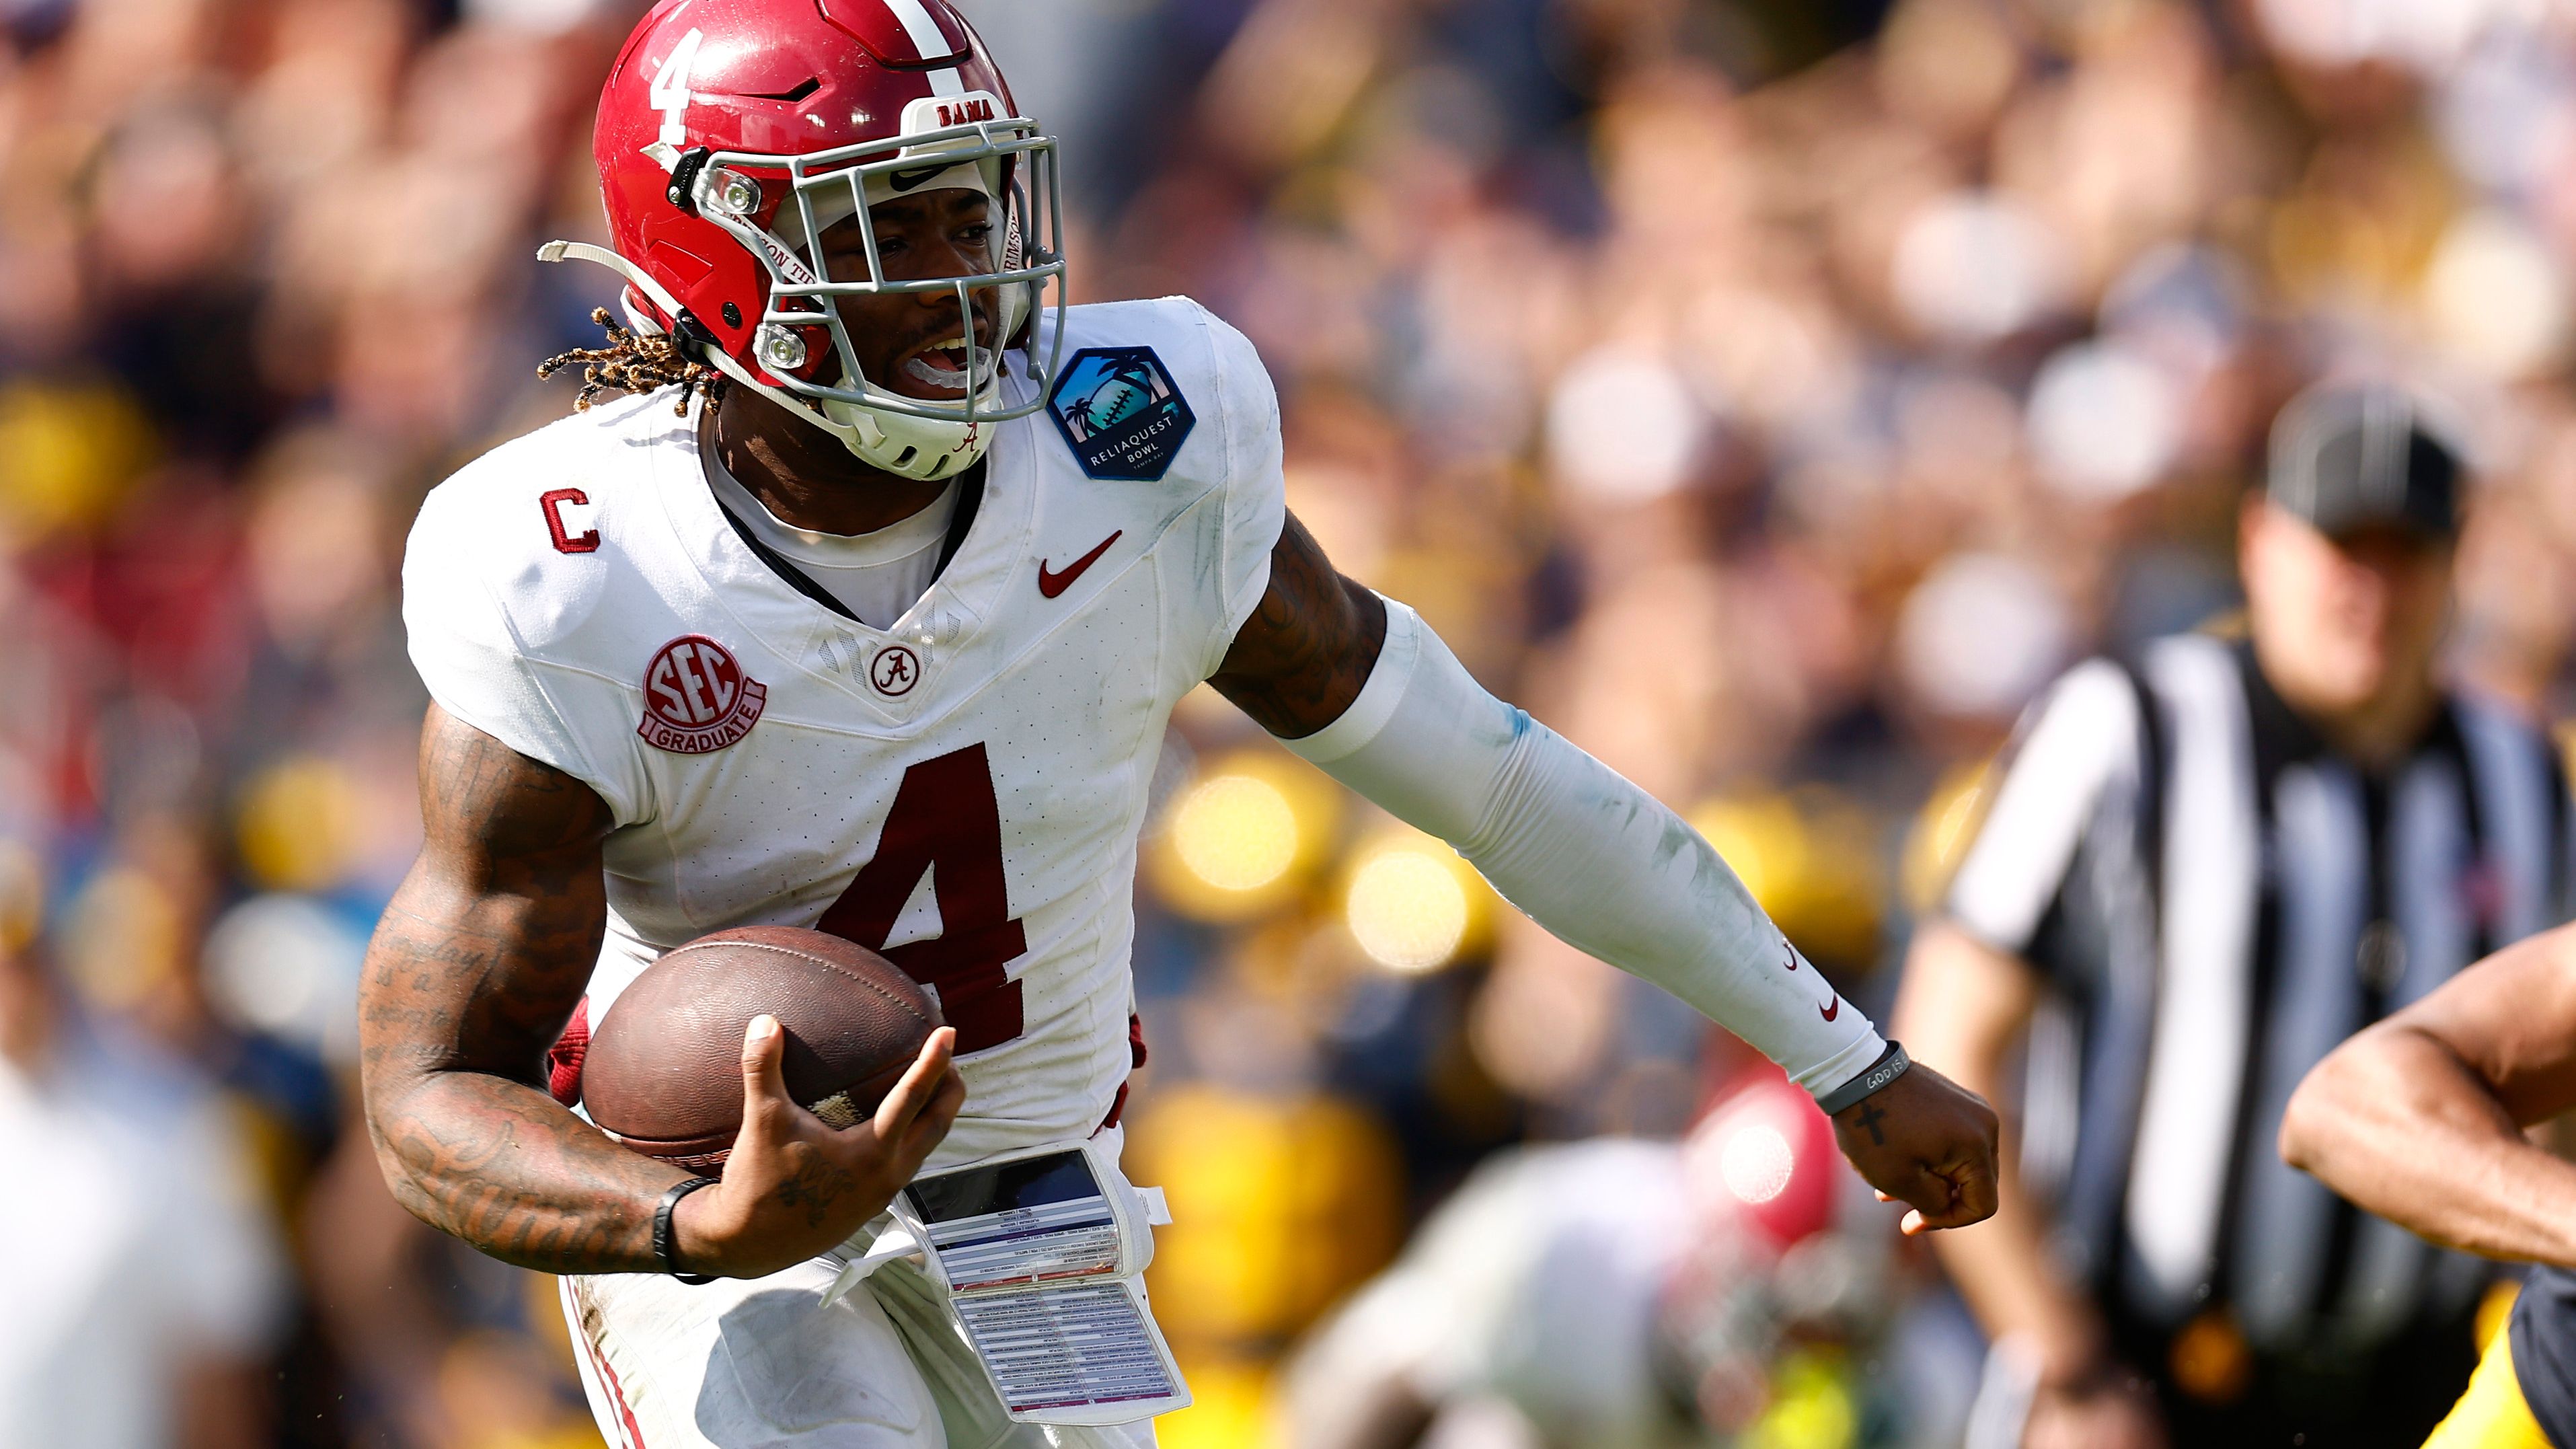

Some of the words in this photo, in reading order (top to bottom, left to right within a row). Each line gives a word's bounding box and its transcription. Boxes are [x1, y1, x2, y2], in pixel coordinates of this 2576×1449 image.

[650, 27, 704, 146] 4
[936, 99, 995, 127] BAMA
[790, 262, 816, 284] TID
[952, 420, 978, 452] A
[1090, 416, 1172, 466] RELIAQUEST
[1127, 442, 1159, 463] BOWL
[539, 488, 601, 554] C
[650, 642, 735, 724] SEC
[879, 652, 910, 688] A
[656, 704, 757, 752] GRADUATE
[812, 740, 1028, 1057] 4
[1866, 1068, 1891, 1089] GOD
[1891, 1059, 1903, 1072] IS
